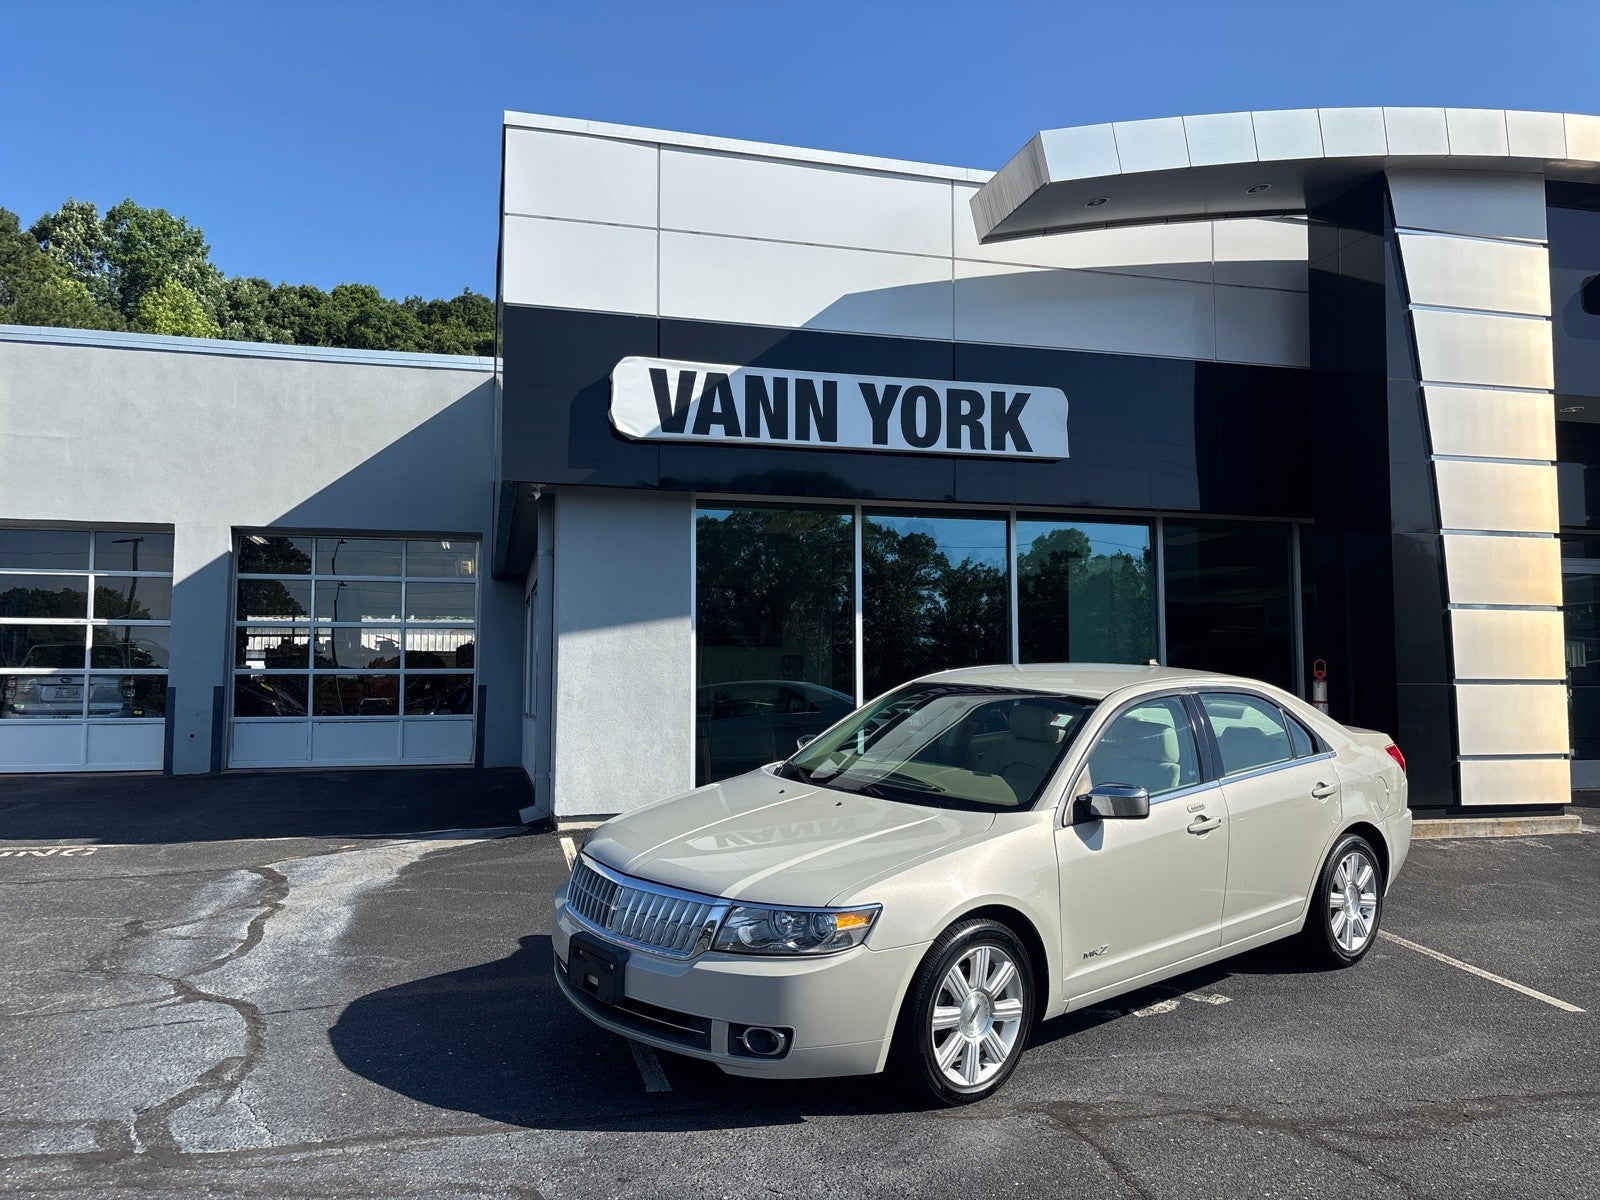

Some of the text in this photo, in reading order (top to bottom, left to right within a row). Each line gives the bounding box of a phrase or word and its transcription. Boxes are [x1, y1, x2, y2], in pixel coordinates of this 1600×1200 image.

[648, 367, 1034, 453] VANN YORK
[1083, 945, 1109, 960] MKZ
